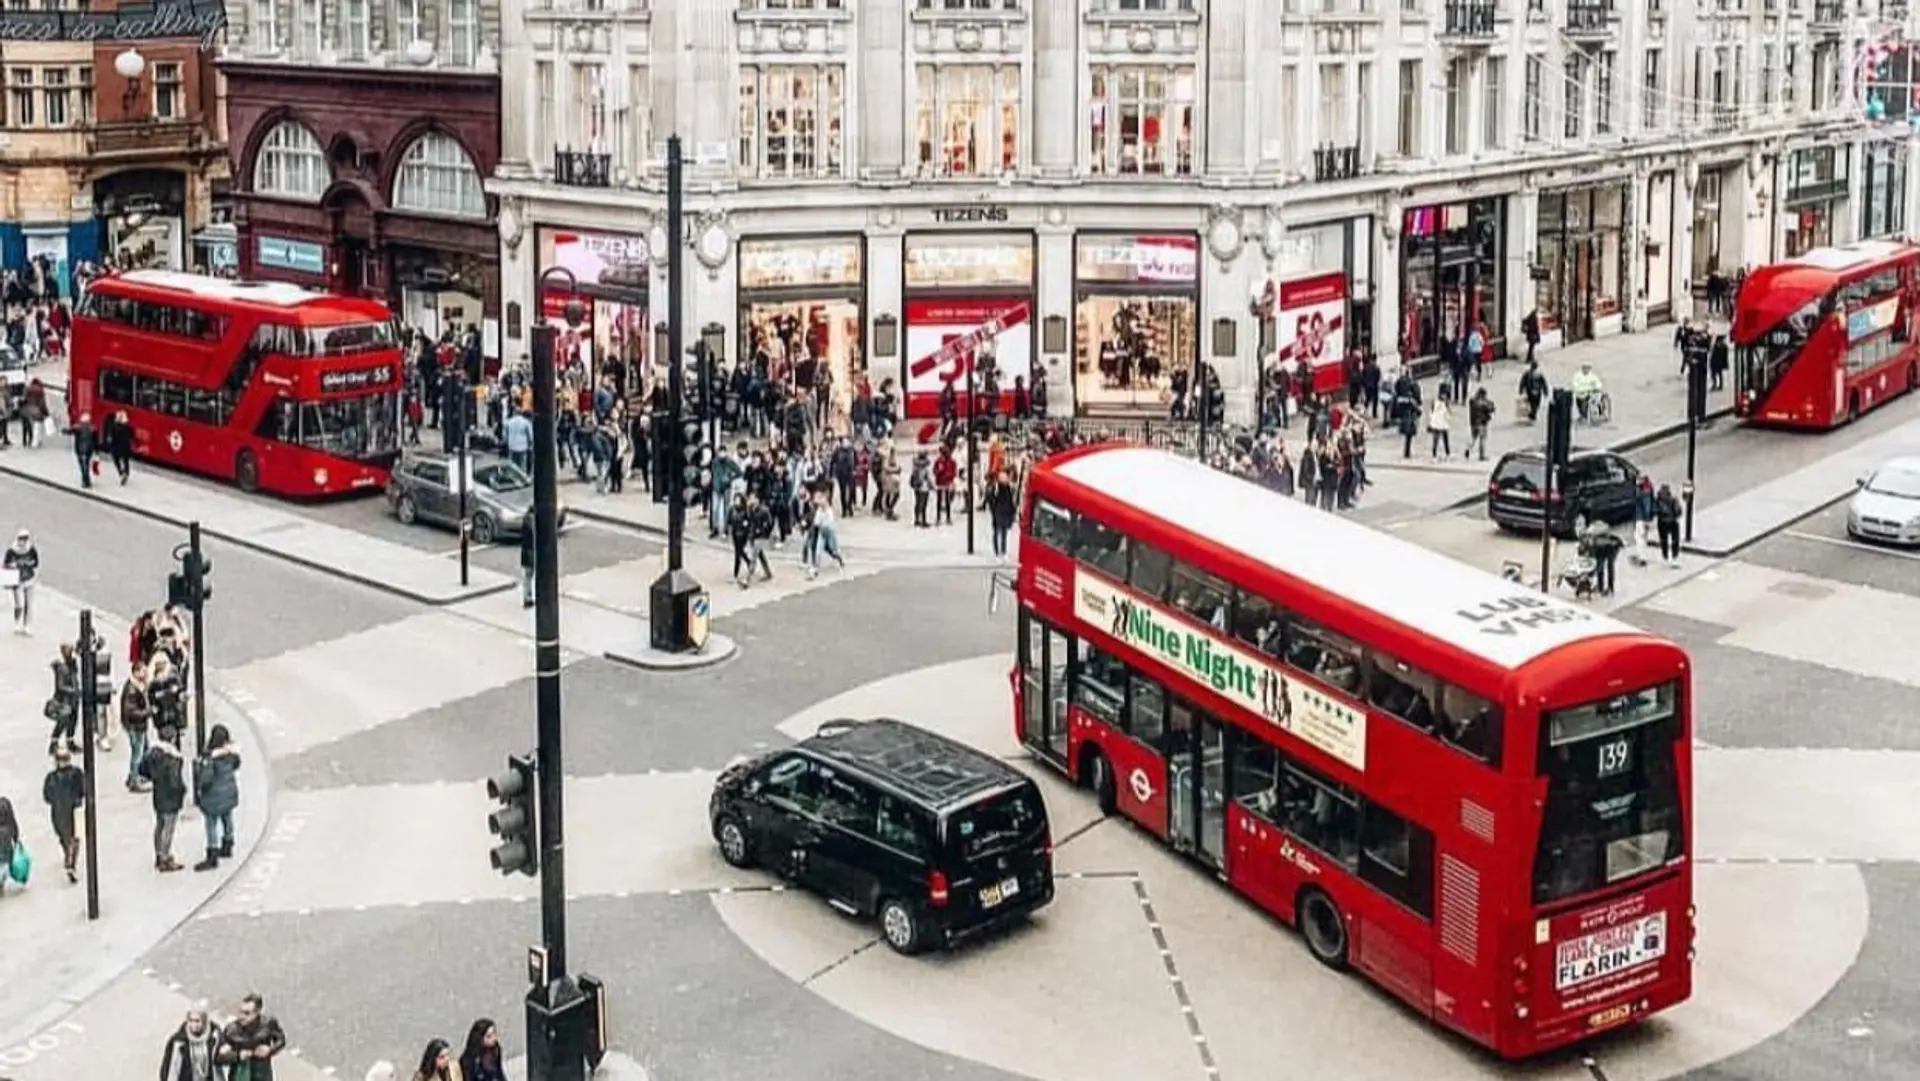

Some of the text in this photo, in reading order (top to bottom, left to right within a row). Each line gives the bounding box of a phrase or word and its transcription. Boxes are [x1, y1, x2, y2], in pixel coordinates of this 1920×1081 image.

[114, 3, 227, 51] calling
[931, 205, 1008, 222] TEZENIS
[1129, 606, 1181, 658] Nine
[1186, 633, 1258, 700] Night
[1599, 740, 1628, 773] 139
[1559, 947, 1630, 984] FLARIN
